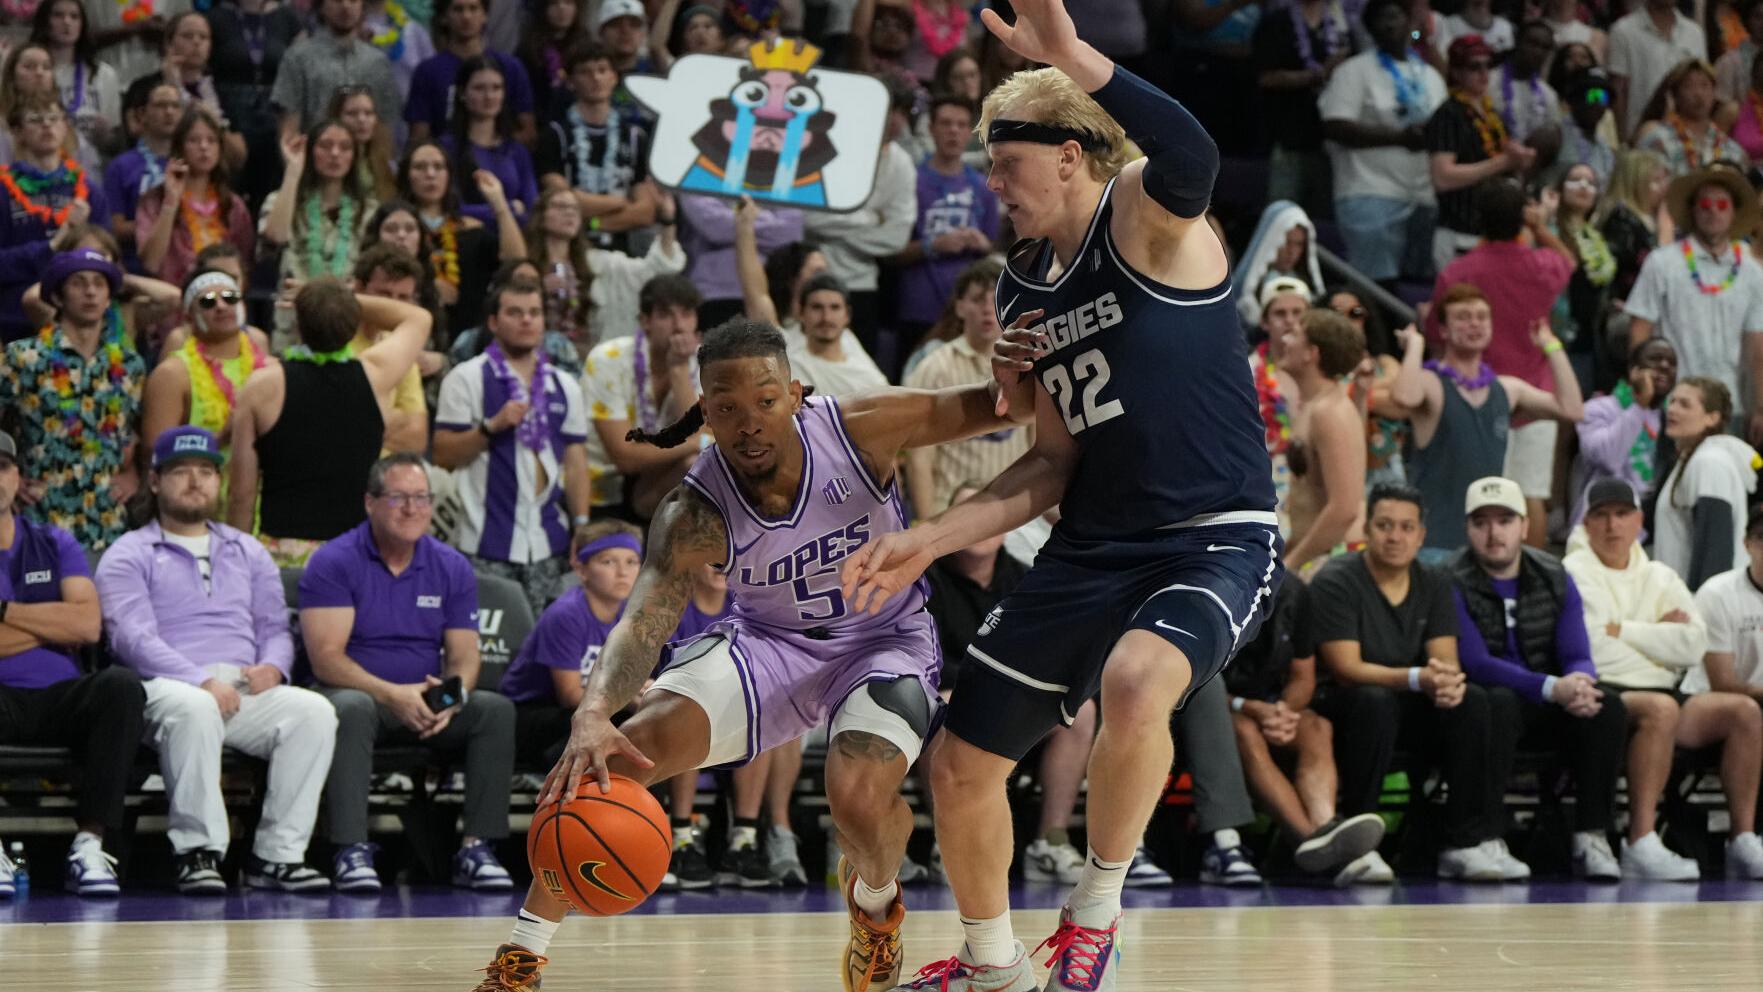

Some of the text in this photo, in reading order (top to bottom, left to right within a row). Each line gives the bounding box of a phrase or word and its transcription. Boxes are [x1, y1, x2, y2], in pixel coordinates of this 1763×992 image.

[1027, 292, 1124, 362] GGIES
[1043, 348, 1124, 436] 22
[739, 512, 871, 587] LOPES
[793, 565, 847, 621] 5
